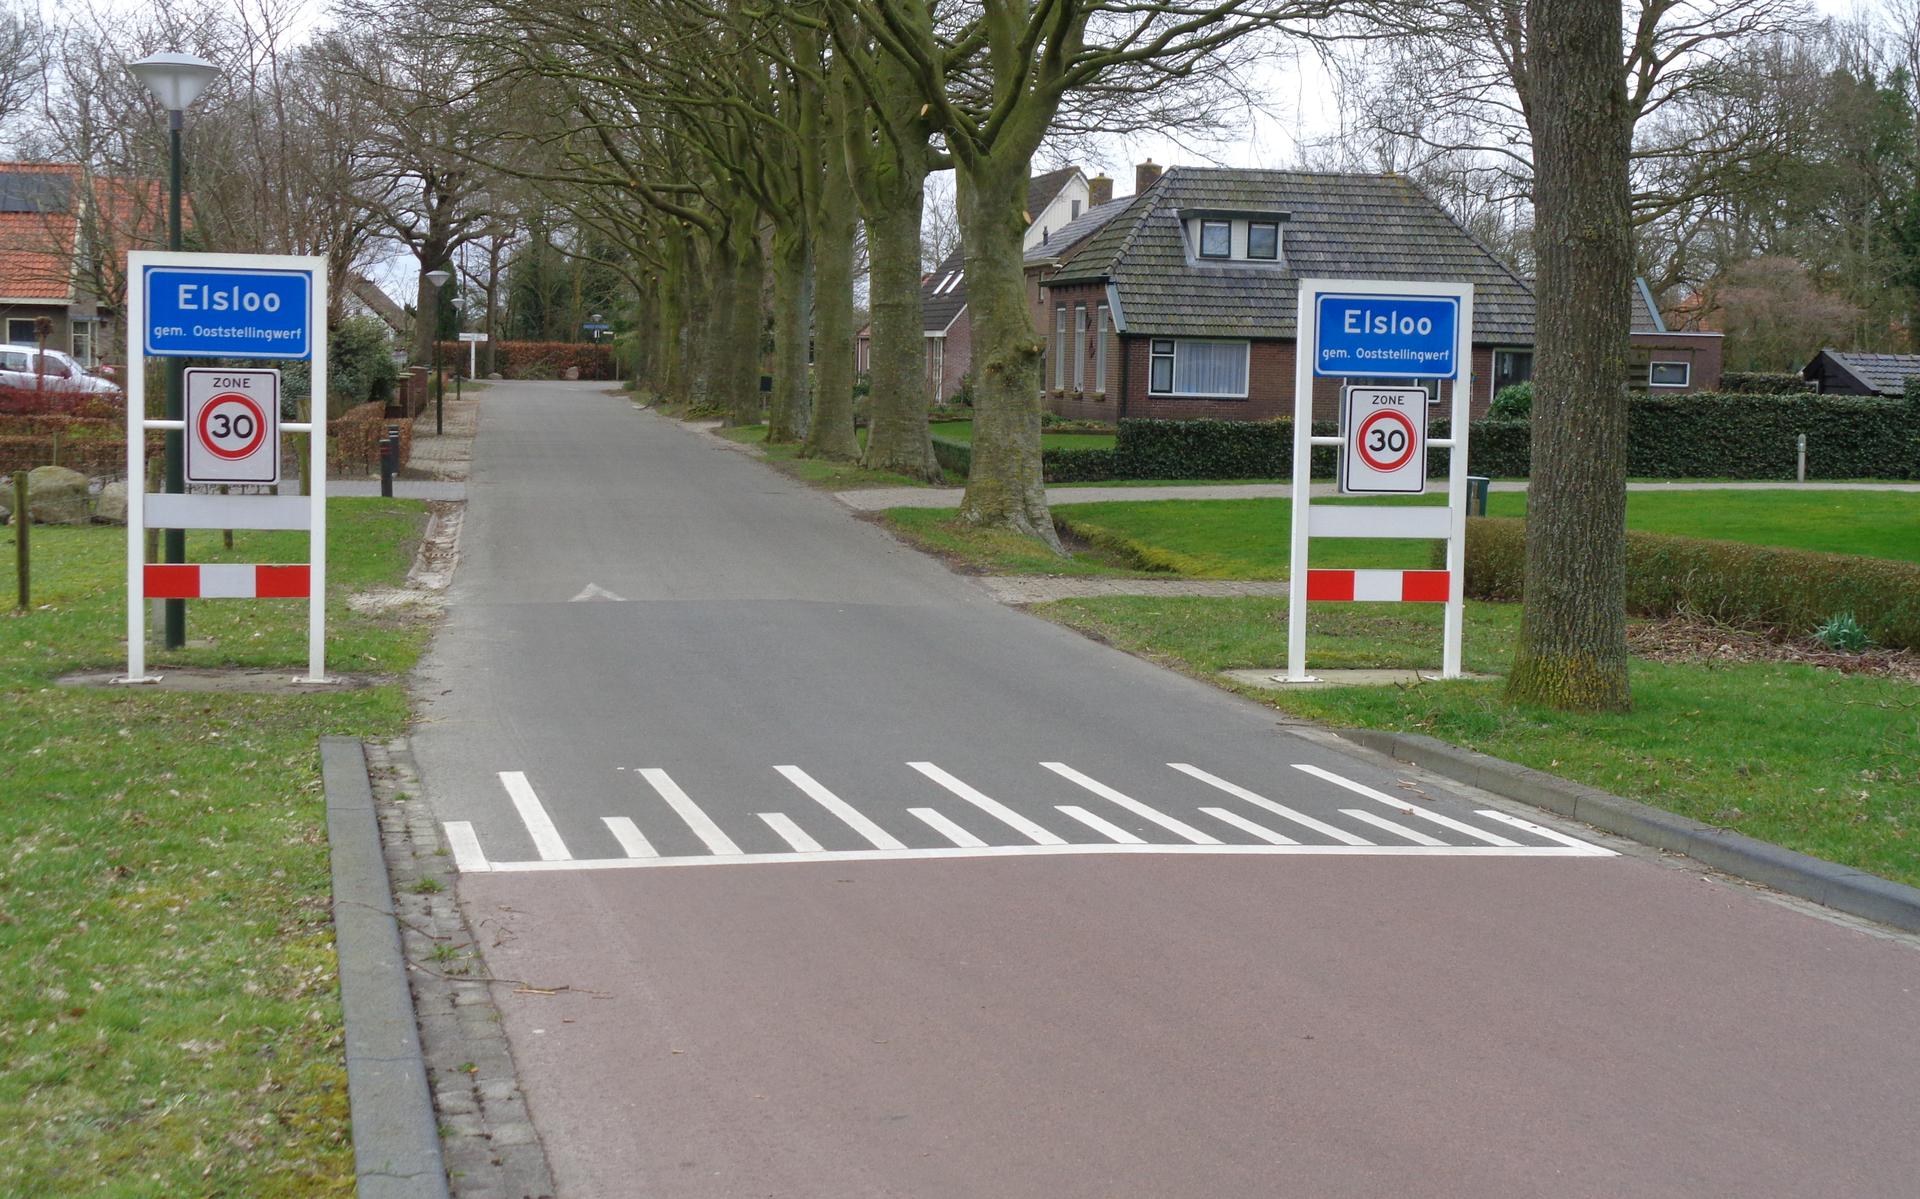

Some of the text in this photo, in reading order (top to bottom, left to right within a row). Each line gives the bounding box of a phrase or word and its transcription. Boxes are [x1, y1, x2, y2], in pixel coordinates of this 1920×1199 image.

[178, 284, 281, 312] Elsloo
[1344, 309, 1432, 335] Elsloo
[154, 325, 302, 342] gem. Ooststellingwerf
[1322, 347, 1450, 363] gem. Ooststellingwerf
[213, 377, 251, 388] ZONE
[1372, 395, 1405, 405] ZONE
[211, 414, 254, 438] 30
[1368, 429, 1406, 452] 30
